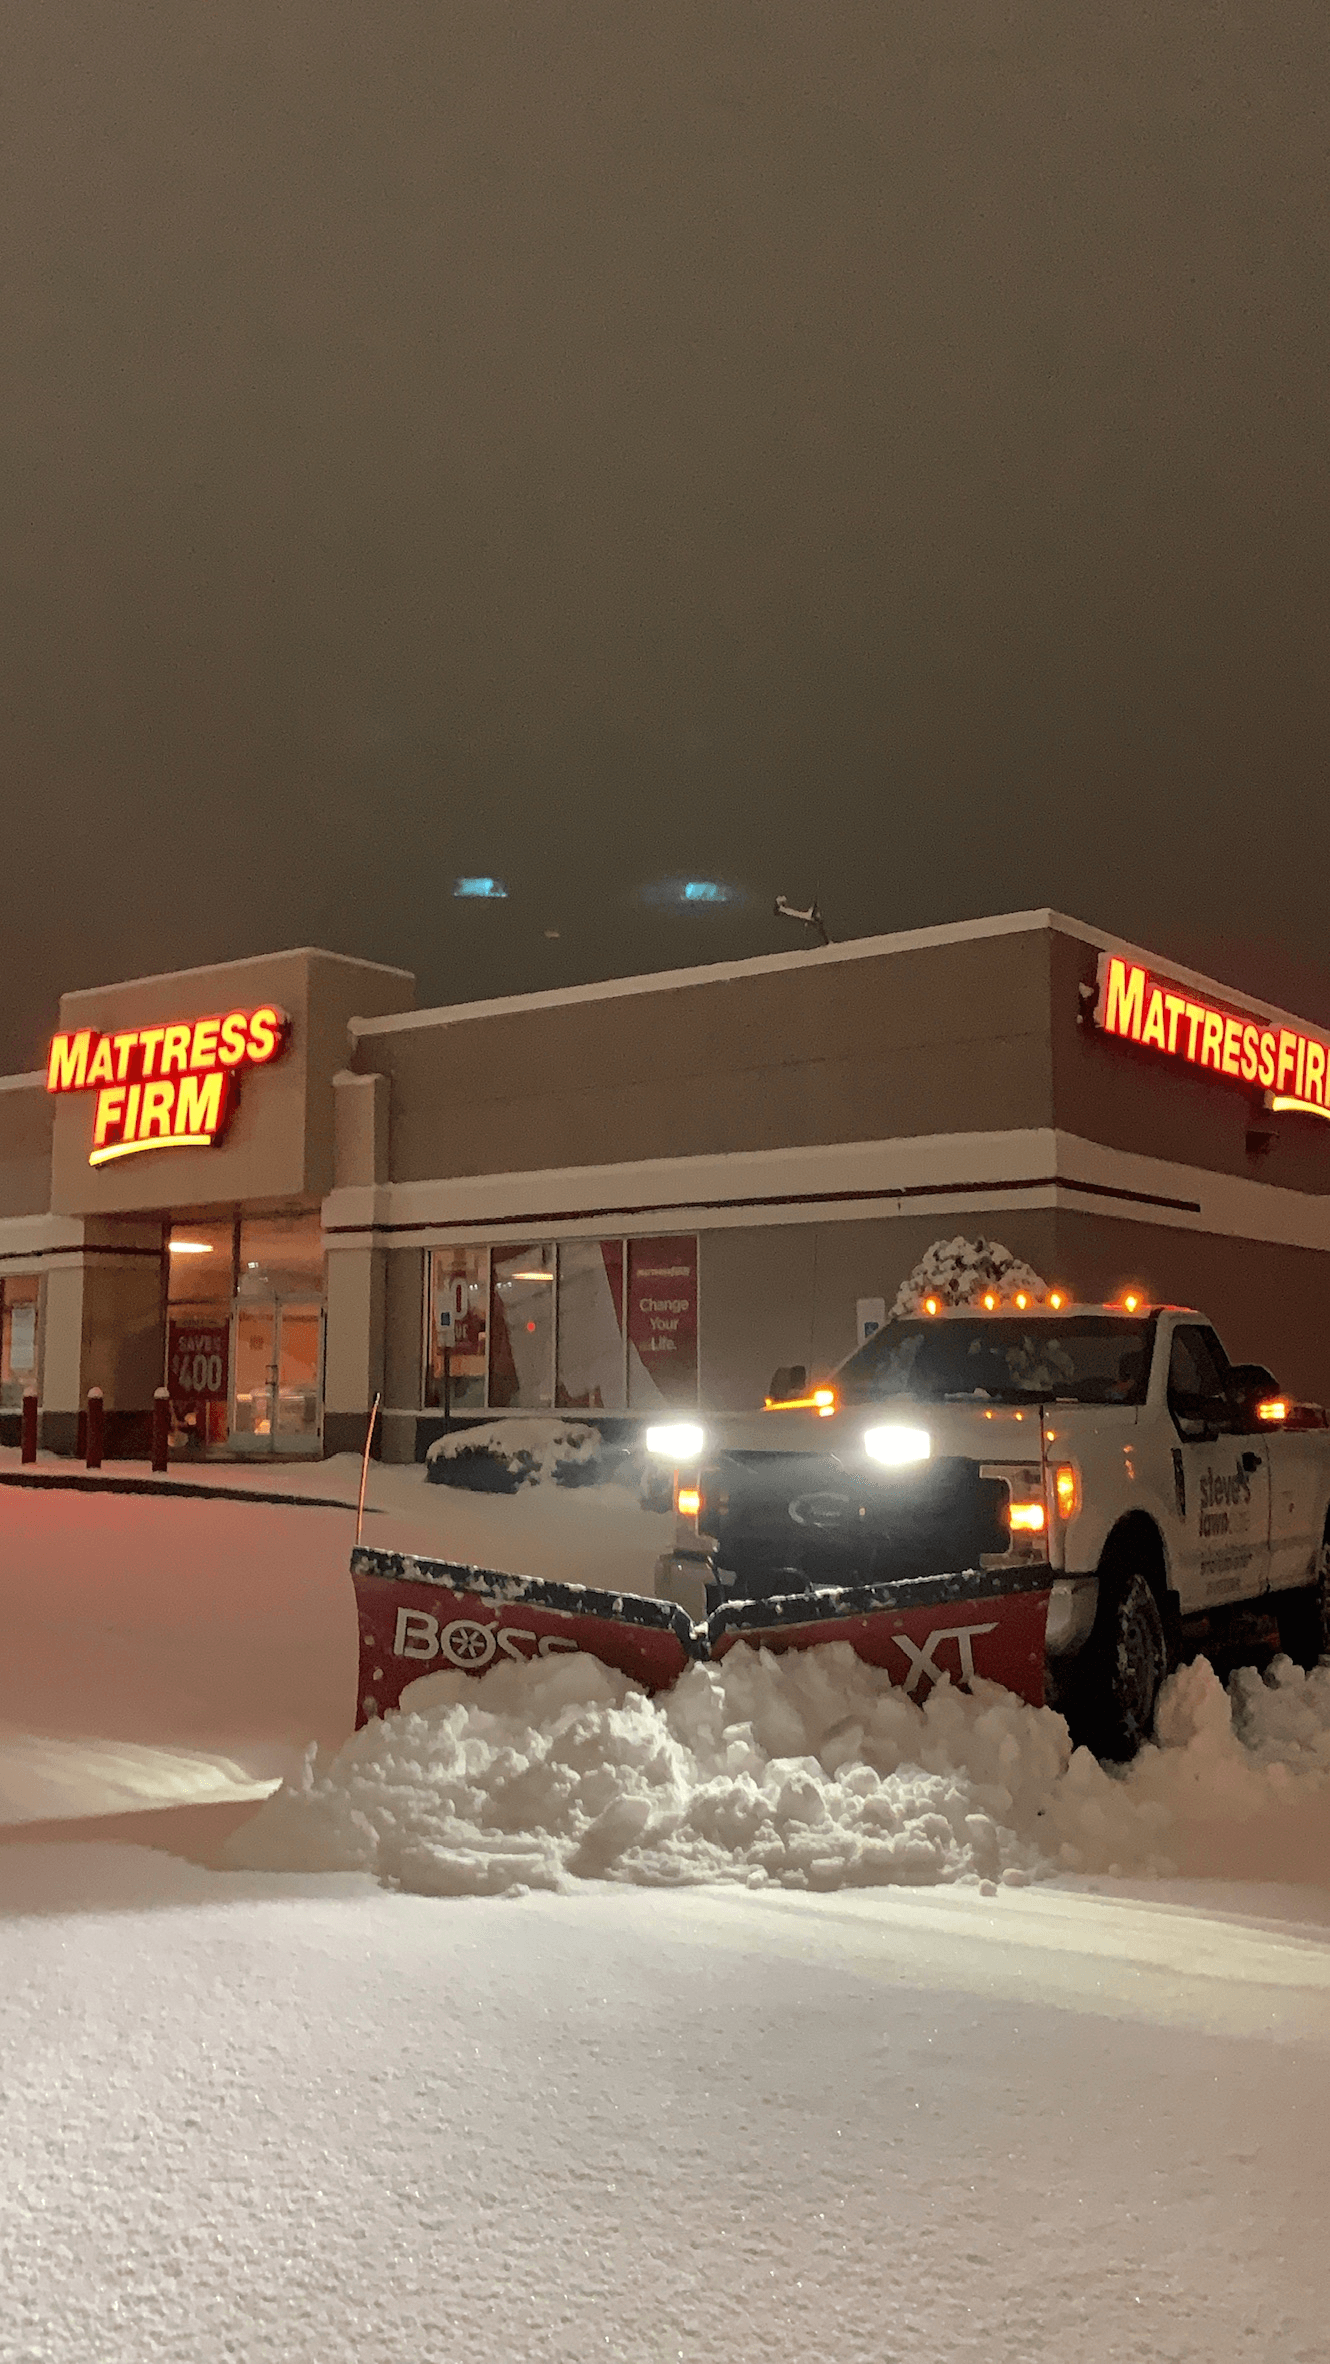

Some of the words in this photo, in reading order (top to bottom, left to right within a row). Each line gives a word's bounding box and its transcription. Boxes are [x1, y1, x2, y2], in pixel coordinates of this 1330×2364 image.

[47, 1008, 277, 1090] MATTRESS
[1104, 957, 1276, 1087] MATTRESS
[1275, 1028, 1330, 1107] FIR
[94, 1072, 225, 1145] FIRM
[639, 1298, 690, 1314] Change
[649, 1317, 679, 1331] Your
[890, 1621, 999, 1692] XT
